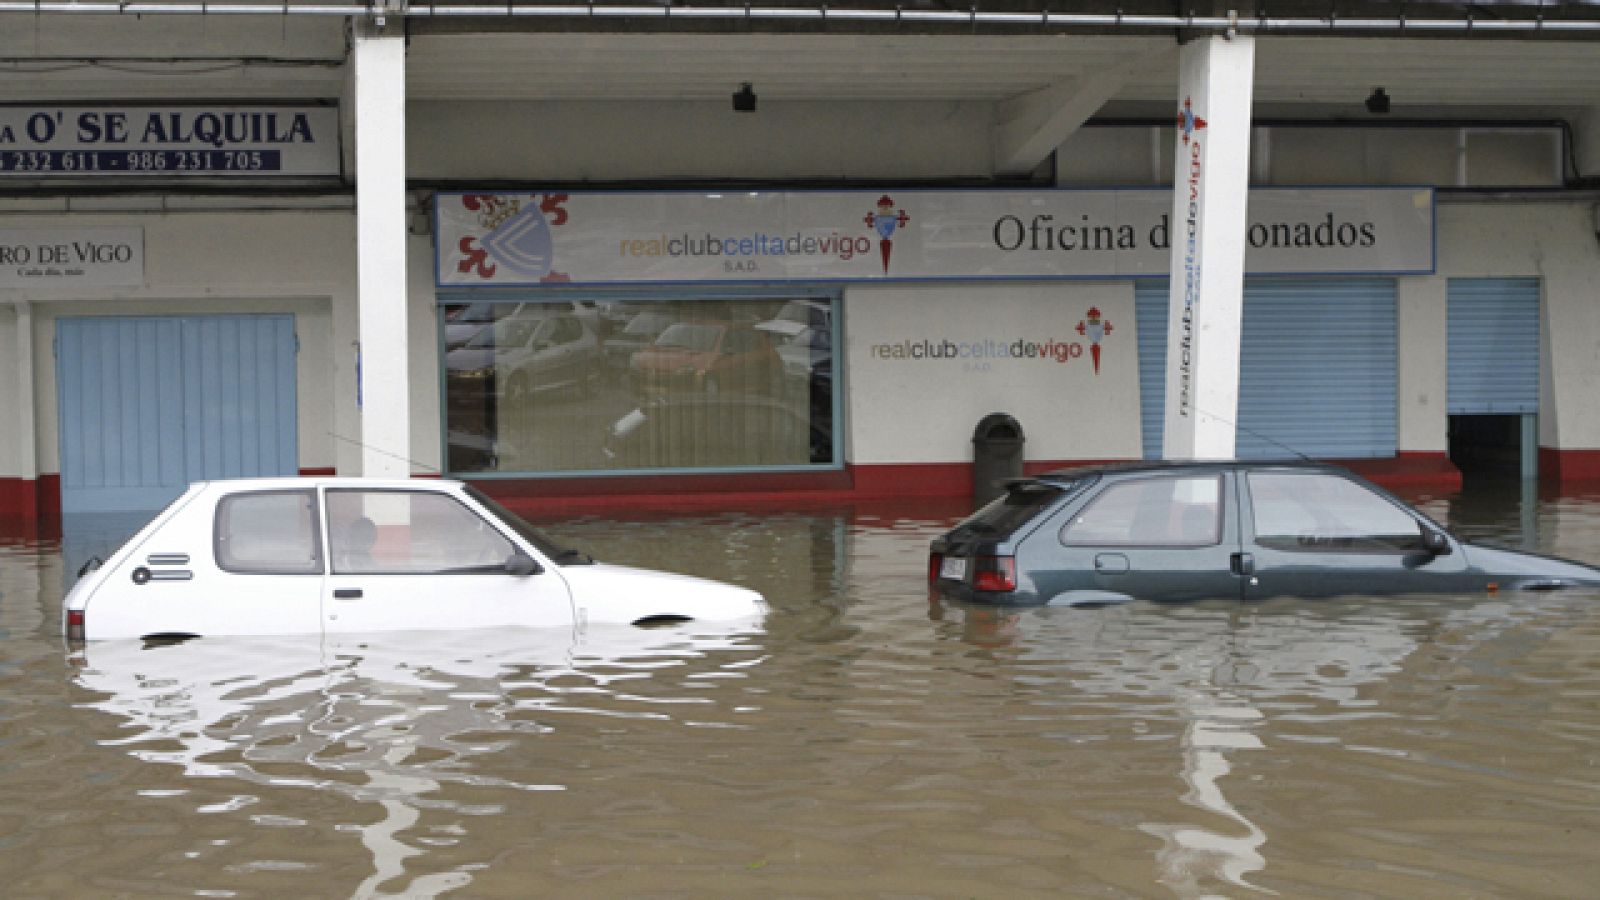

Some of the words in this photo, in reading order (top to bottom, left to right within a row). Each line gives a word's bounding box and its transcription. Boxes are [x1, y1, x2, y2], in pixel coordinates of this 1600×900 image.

[77, 112, 128, 143] SE
[141, 111, 313, 147] ALQUILA
[14, 151, 51, 170] 232
[62, 151, 99, 170] 611
[127, 151, 166, 170] 986
[175, 151, 213, 170] 231
[225, 151, 262, 170] 705
[994, 215, 1136, 251] Oficina
[1149, 213, 1171, 251] d
[1248, 213, 1377, 249] onados
[0, 244, 31, 265] RO
[38, 244, 69, 264] DE
[72, 241, 133, 264] VIGO
[621, 233, 870, 259] realclubceltadevigo
[1180, 142, 1201, 416] realclubceltadevigo
[871, 338, 1082, 363] realclubceltadevigo
